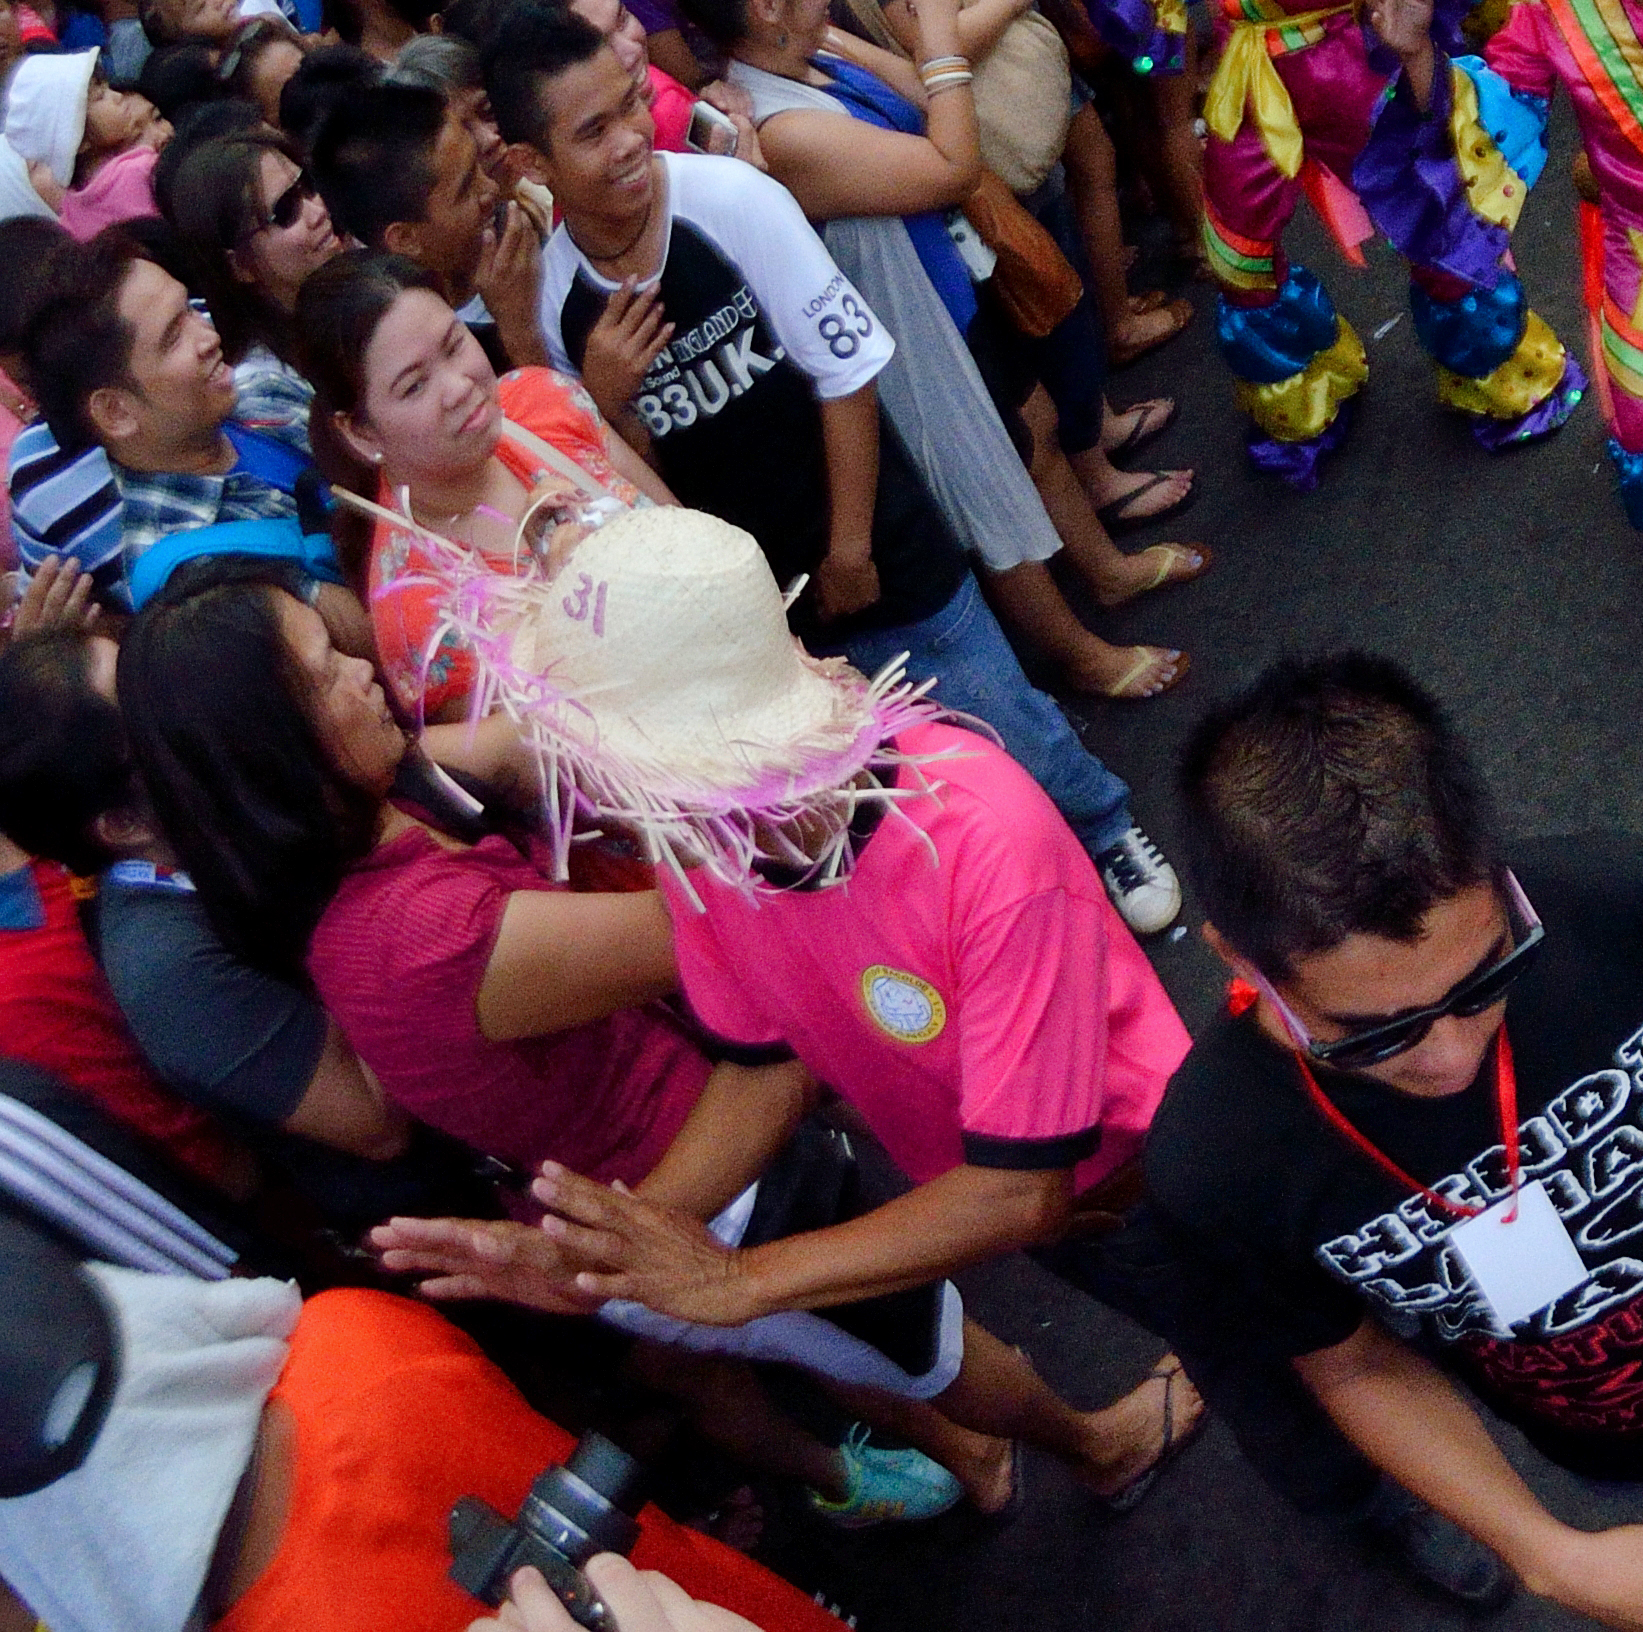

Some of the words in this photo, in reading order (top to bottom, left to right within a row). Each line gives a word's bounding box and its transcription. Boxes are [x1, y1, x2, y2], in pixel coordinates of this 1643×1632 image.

[801, 272, 845, 320] LONDON
[817, 293, 874, 360] 83
[562, 570, 609, 639] 31
